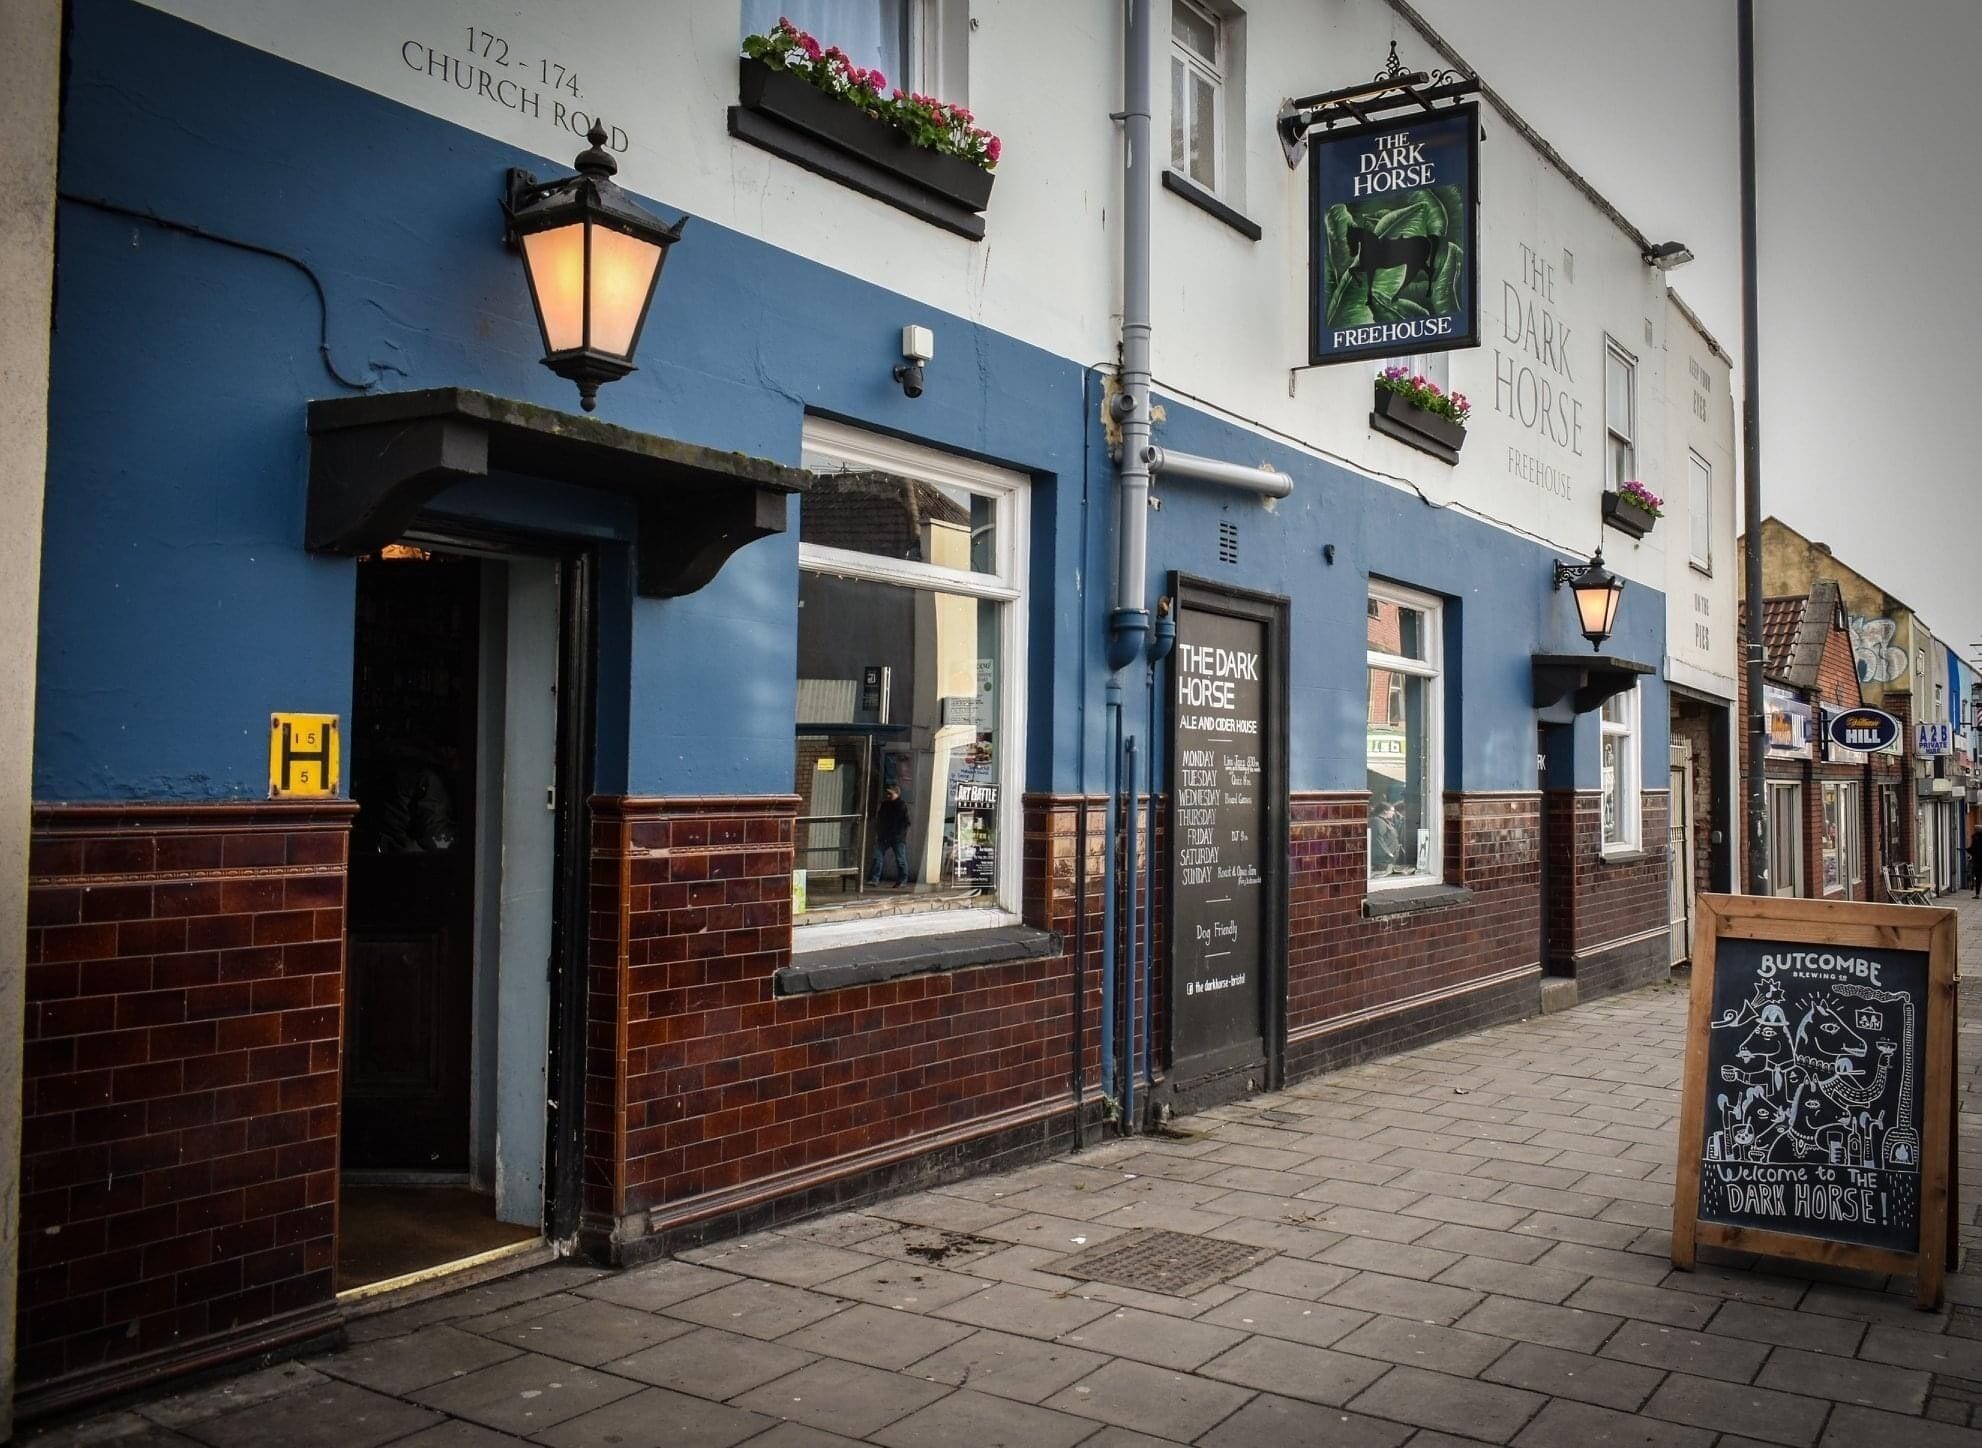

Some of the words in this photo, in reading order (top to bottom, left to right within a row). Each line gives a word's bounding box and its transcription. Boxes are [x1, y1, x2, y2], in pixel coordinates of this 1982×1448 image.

[466, 26, 509, 67] 172
[401, 40, 540, 118] CHURCH
[552, 100, 629, 153] ROD
[1374, 131, 1410, 151] THE
[1359, 143, 1426, 174] DARK
[1353, 163, 1436, 197] HORSE
[1518, 241, 1555, 305] THE
[1332, 316, 1452, 349] FREEHOUSE
[1502, 279, 1574, 384] DARK
[1493, 348, 1583, 457] HORSE
[1507, 446, 1572, 501] FREEHOUSE
[1179, 643, 1214, 675] THE
[1215, 648, 1259, 681] DARK
[1178, 675, 1236, 710] HORSE
[1179, 714, 1198, 730] ALE
[1198, 715, 1215, 731] AND
[1215, 717, 1236, 732] CIDER
[1235, 719, 1257, 734] HOUSE
[1845, 728, 1881, 744] HILL
[1919, 725, 1928, 742] A
[1930, 724, 1937, 742] 2
[1941, 724, 1948, 742] B
[281, 722, 330, 790] H
[1918, 741, 1948, 749] PRIVATE
[1182, 749, 1215, 767] MONDAY
[300, 771, 309, 784] 5
[1181, 769, 1218, 787] TUESDAY
[970, 785, 998, 802] BATTLE
[1178, 788, 1221, 807] WEDNESDAY
[1177, 808, 1217, 827] THURSDAY
[1187, 827, 1214, 845] FRIDAY
[1179, 846, 1220, 867] SATURDAY
[1182, 866, 1213, 886] SUNDAY
[1195, 924, 1211, 946] Dog
[1214, 919, 1238, 943] Friendly
[1756, 952, 1882, 987] BUTCOMBE
[1792, 971, 1837, 980] BREWING
[1717, 1163, 1808, 1183] Welcome
[1815, 1165, 1836, 1182] to
[1847, 1168, 1878, 1188] THE
[1726, 1183, 1787, 1217] DARK
[1794, 1183, 1888, 1226] HORSE!
